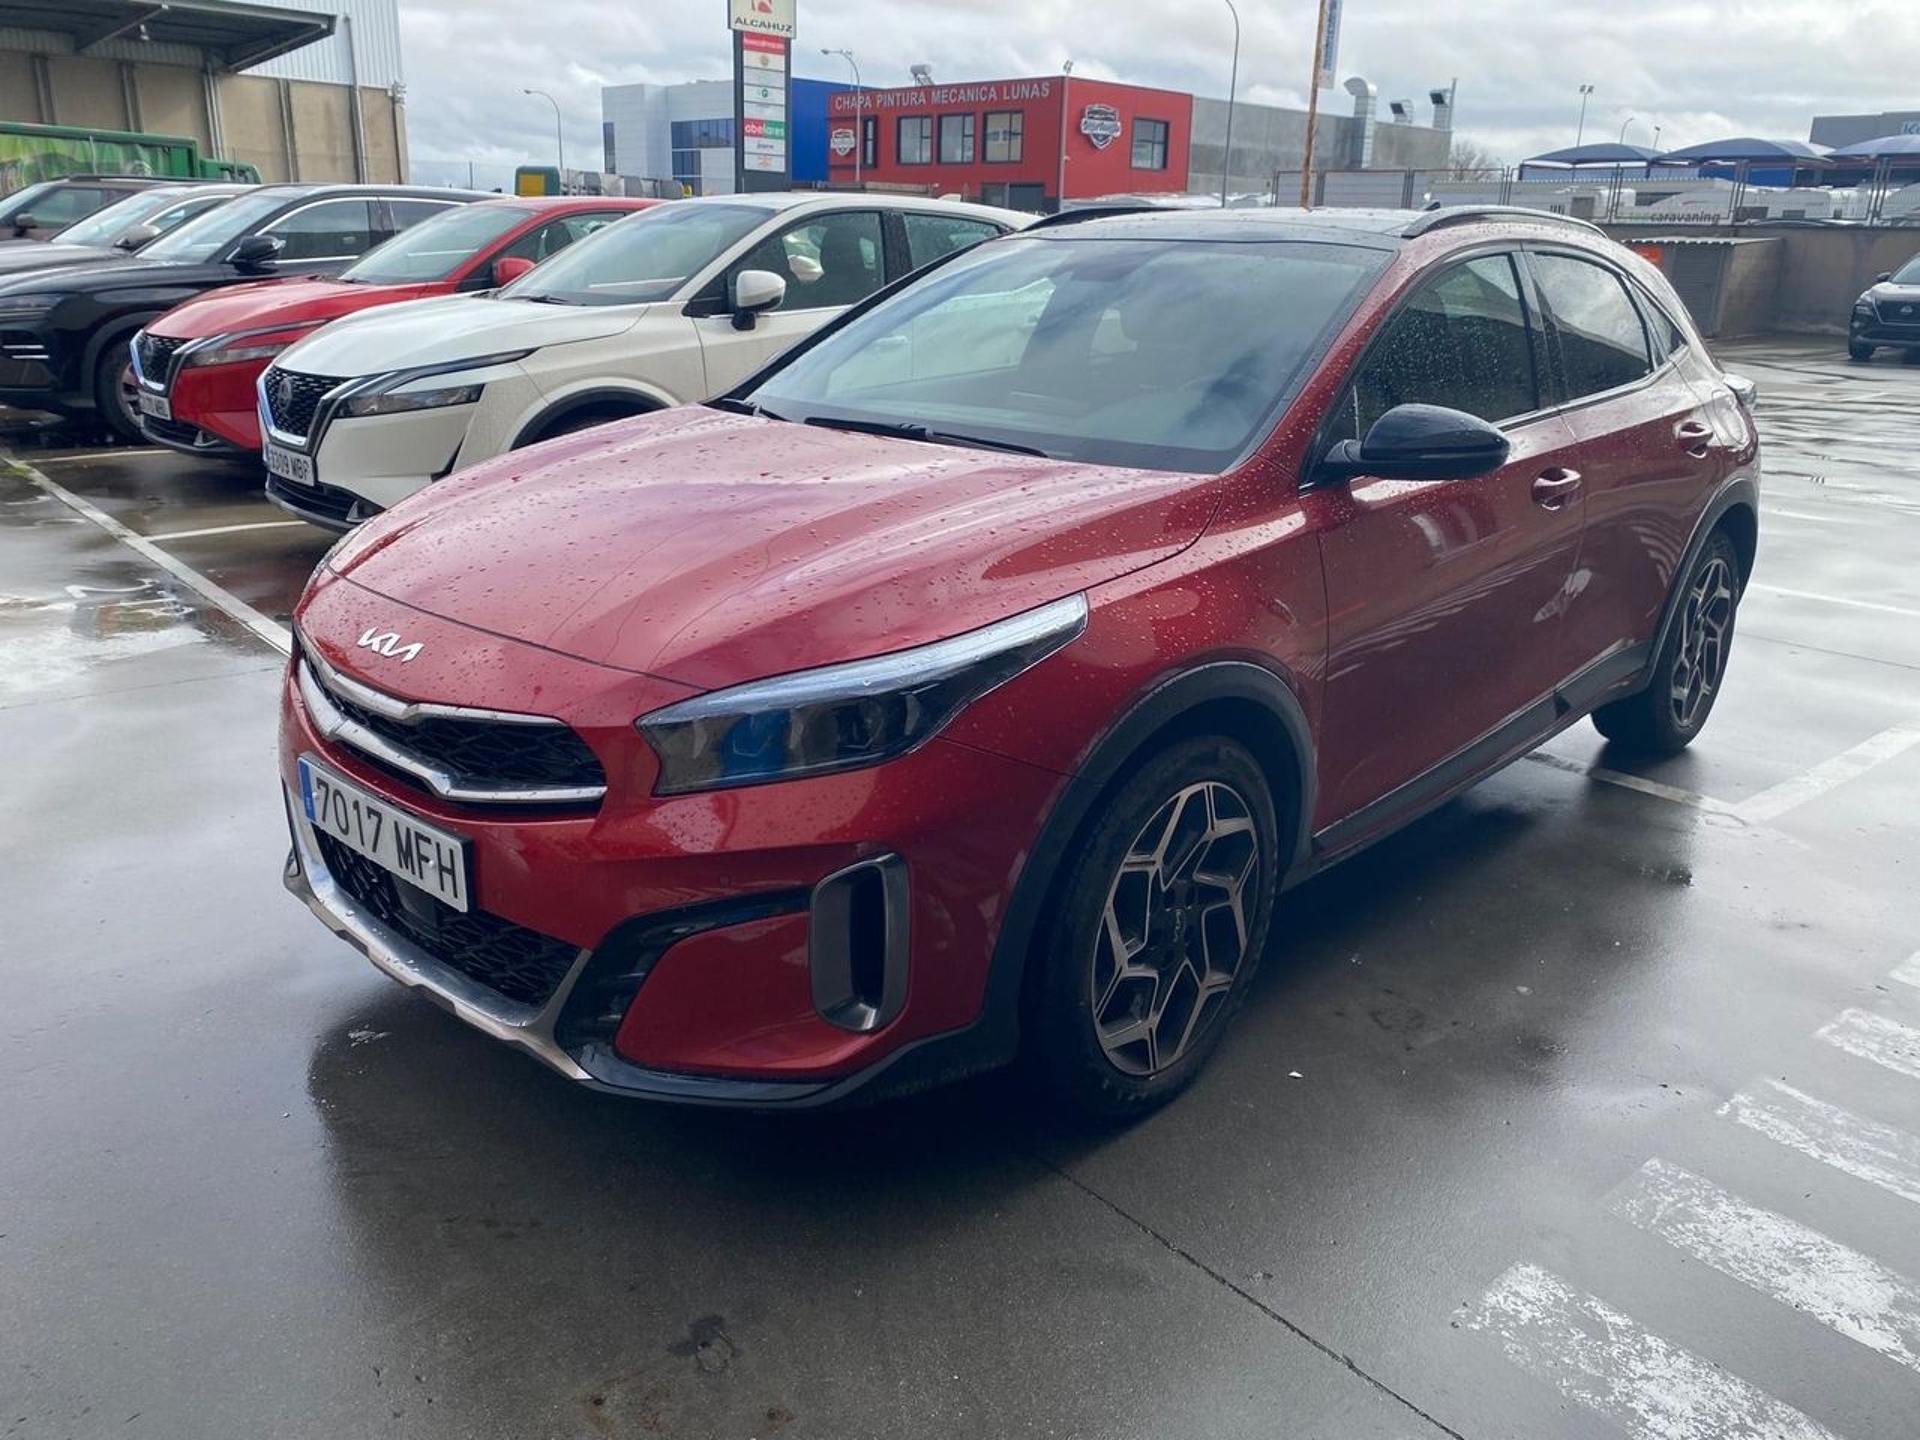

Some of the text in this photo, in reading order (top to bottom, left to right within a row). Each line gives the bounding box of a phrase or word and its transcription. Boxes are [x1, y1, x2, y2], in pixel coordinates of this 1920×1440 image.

[734, 17, 792, 32] ALCAHUZ
[835, 82, 1050, 110] CHAPA PINTURA MECANICA LUNAS
[1650, 210, 1720, 225] caravaning
[357, 627, 424, 662] KIA
[316, 776, 459, 899] 7017 MFH
